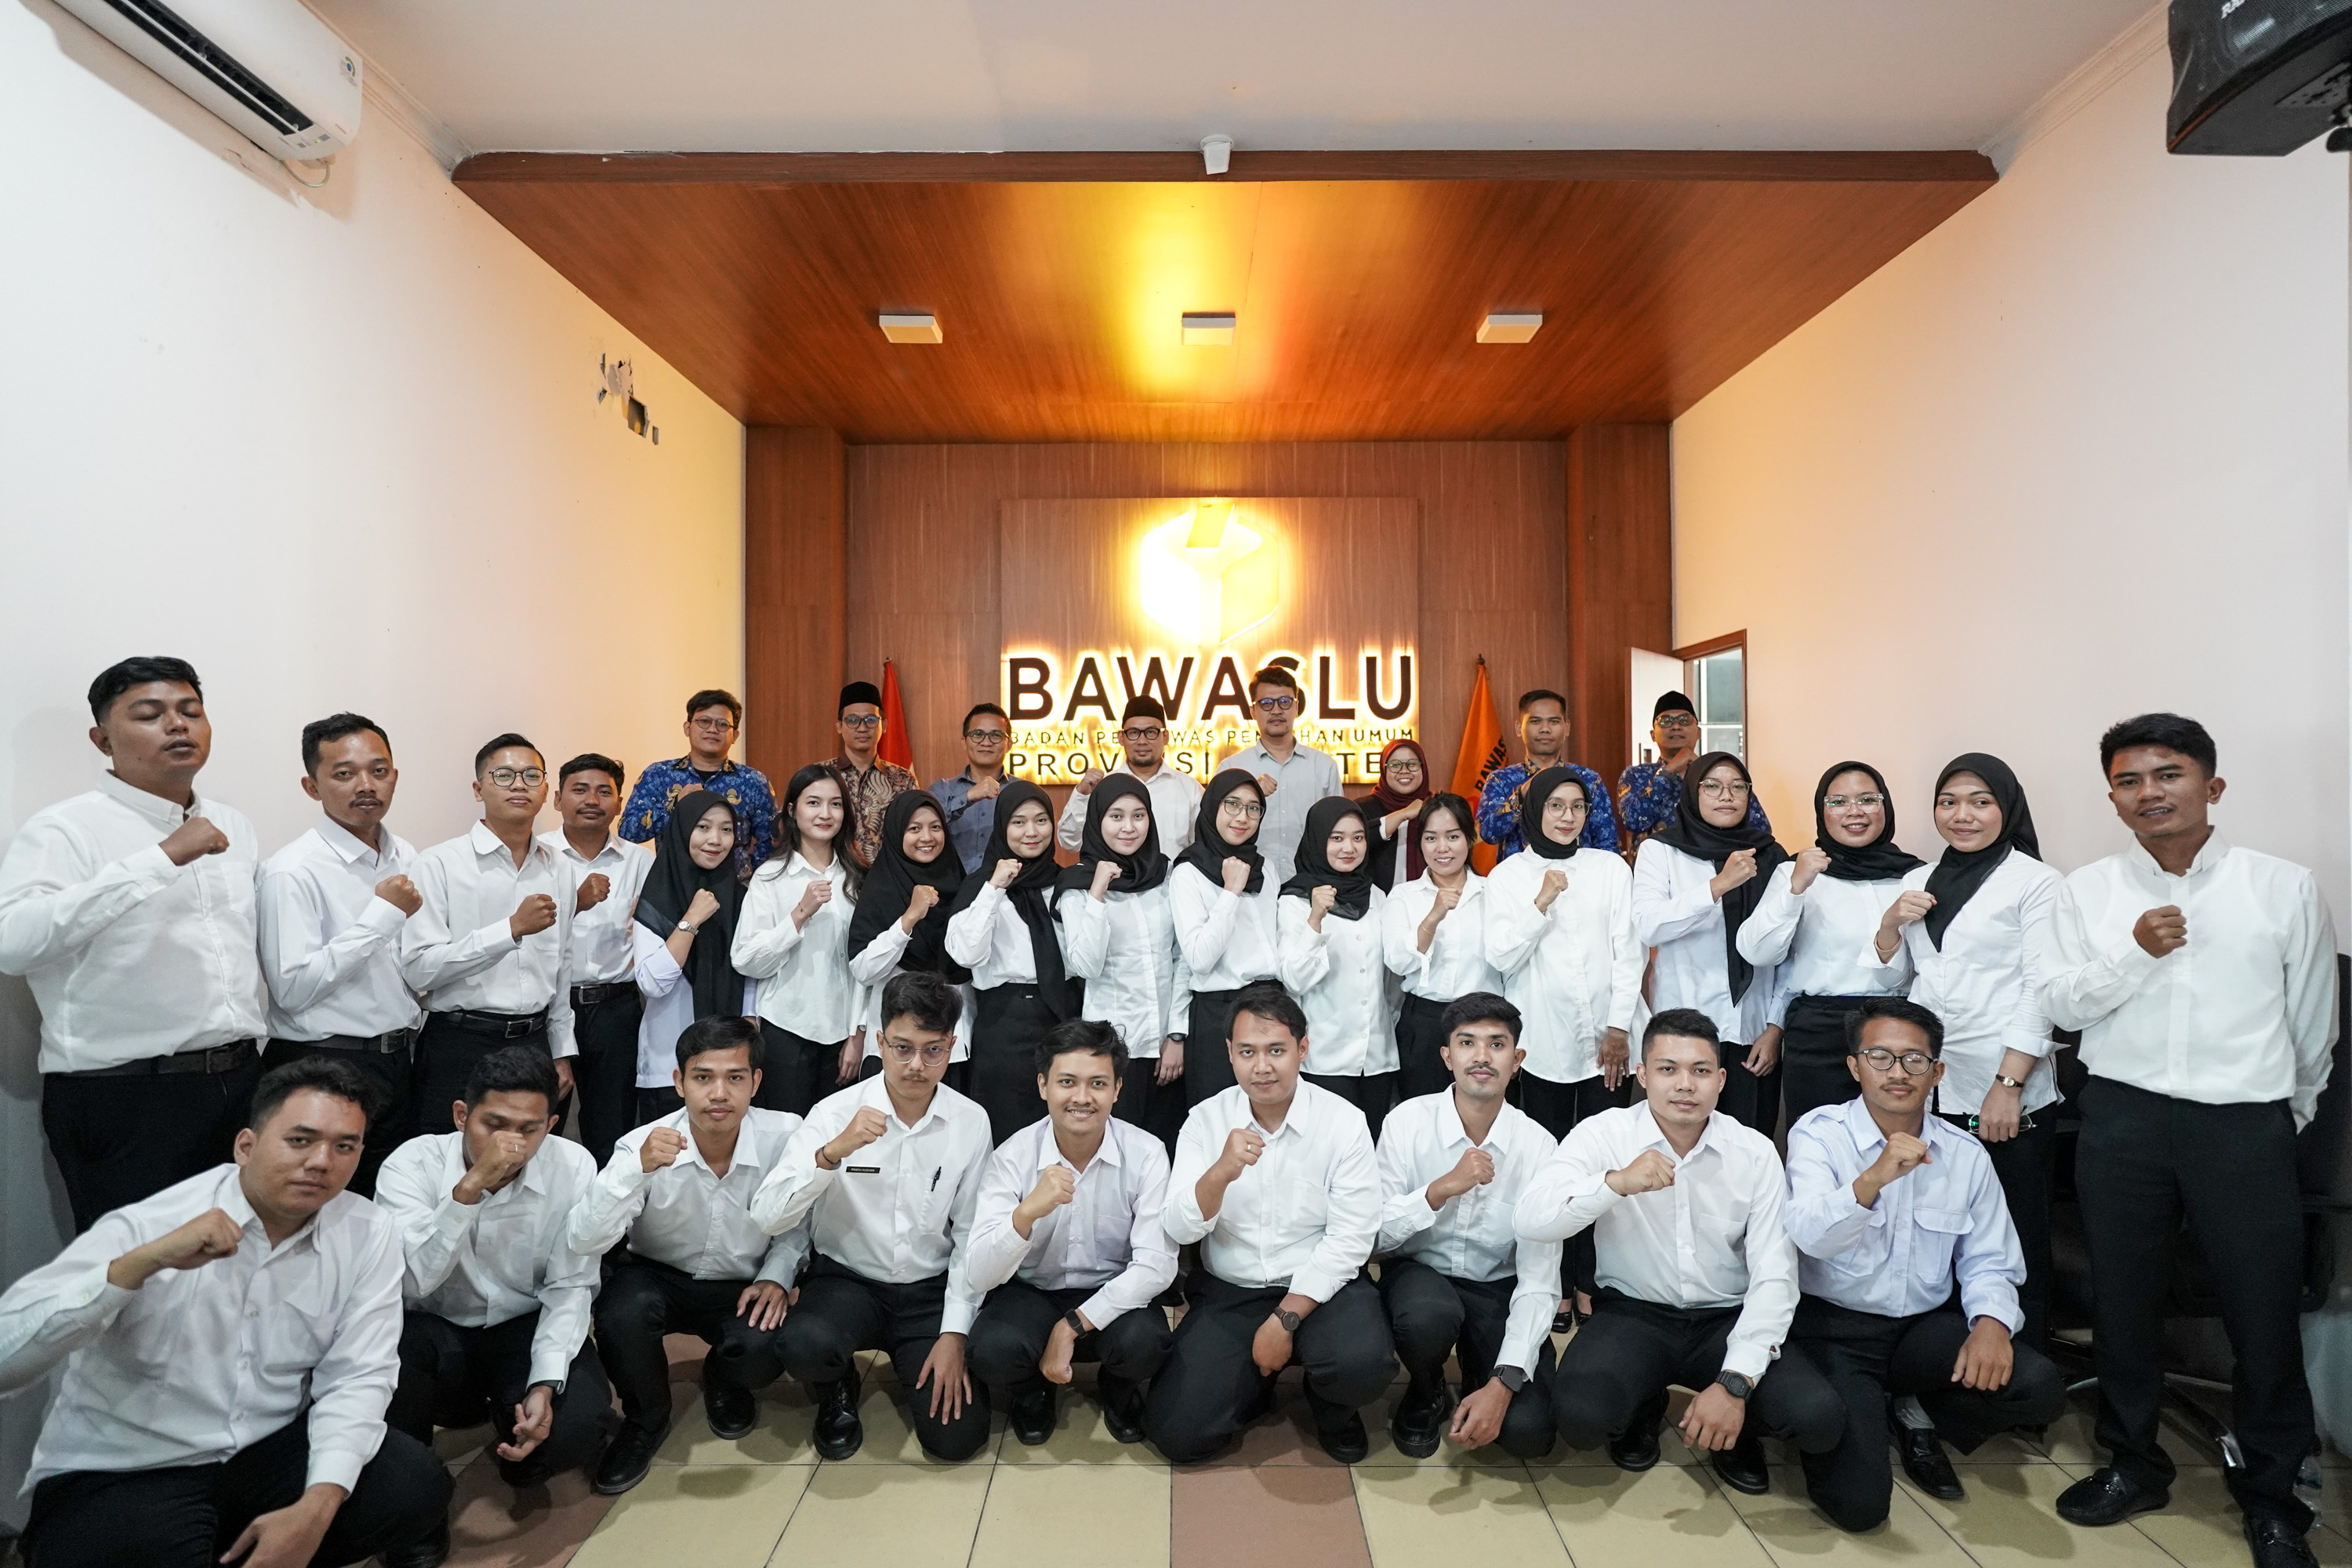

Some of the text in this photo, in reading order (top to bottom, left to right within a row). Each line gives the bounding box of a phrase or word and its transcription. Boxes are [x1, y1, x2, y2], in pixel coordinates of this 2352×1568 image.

[1011, 731, 1084, 745] BADAN
[1097, 730, 1214, 746] PEWAS
[1354, 729, 1412, 742] UMUM
[1009, 752, 1209, 775] PROVSI
